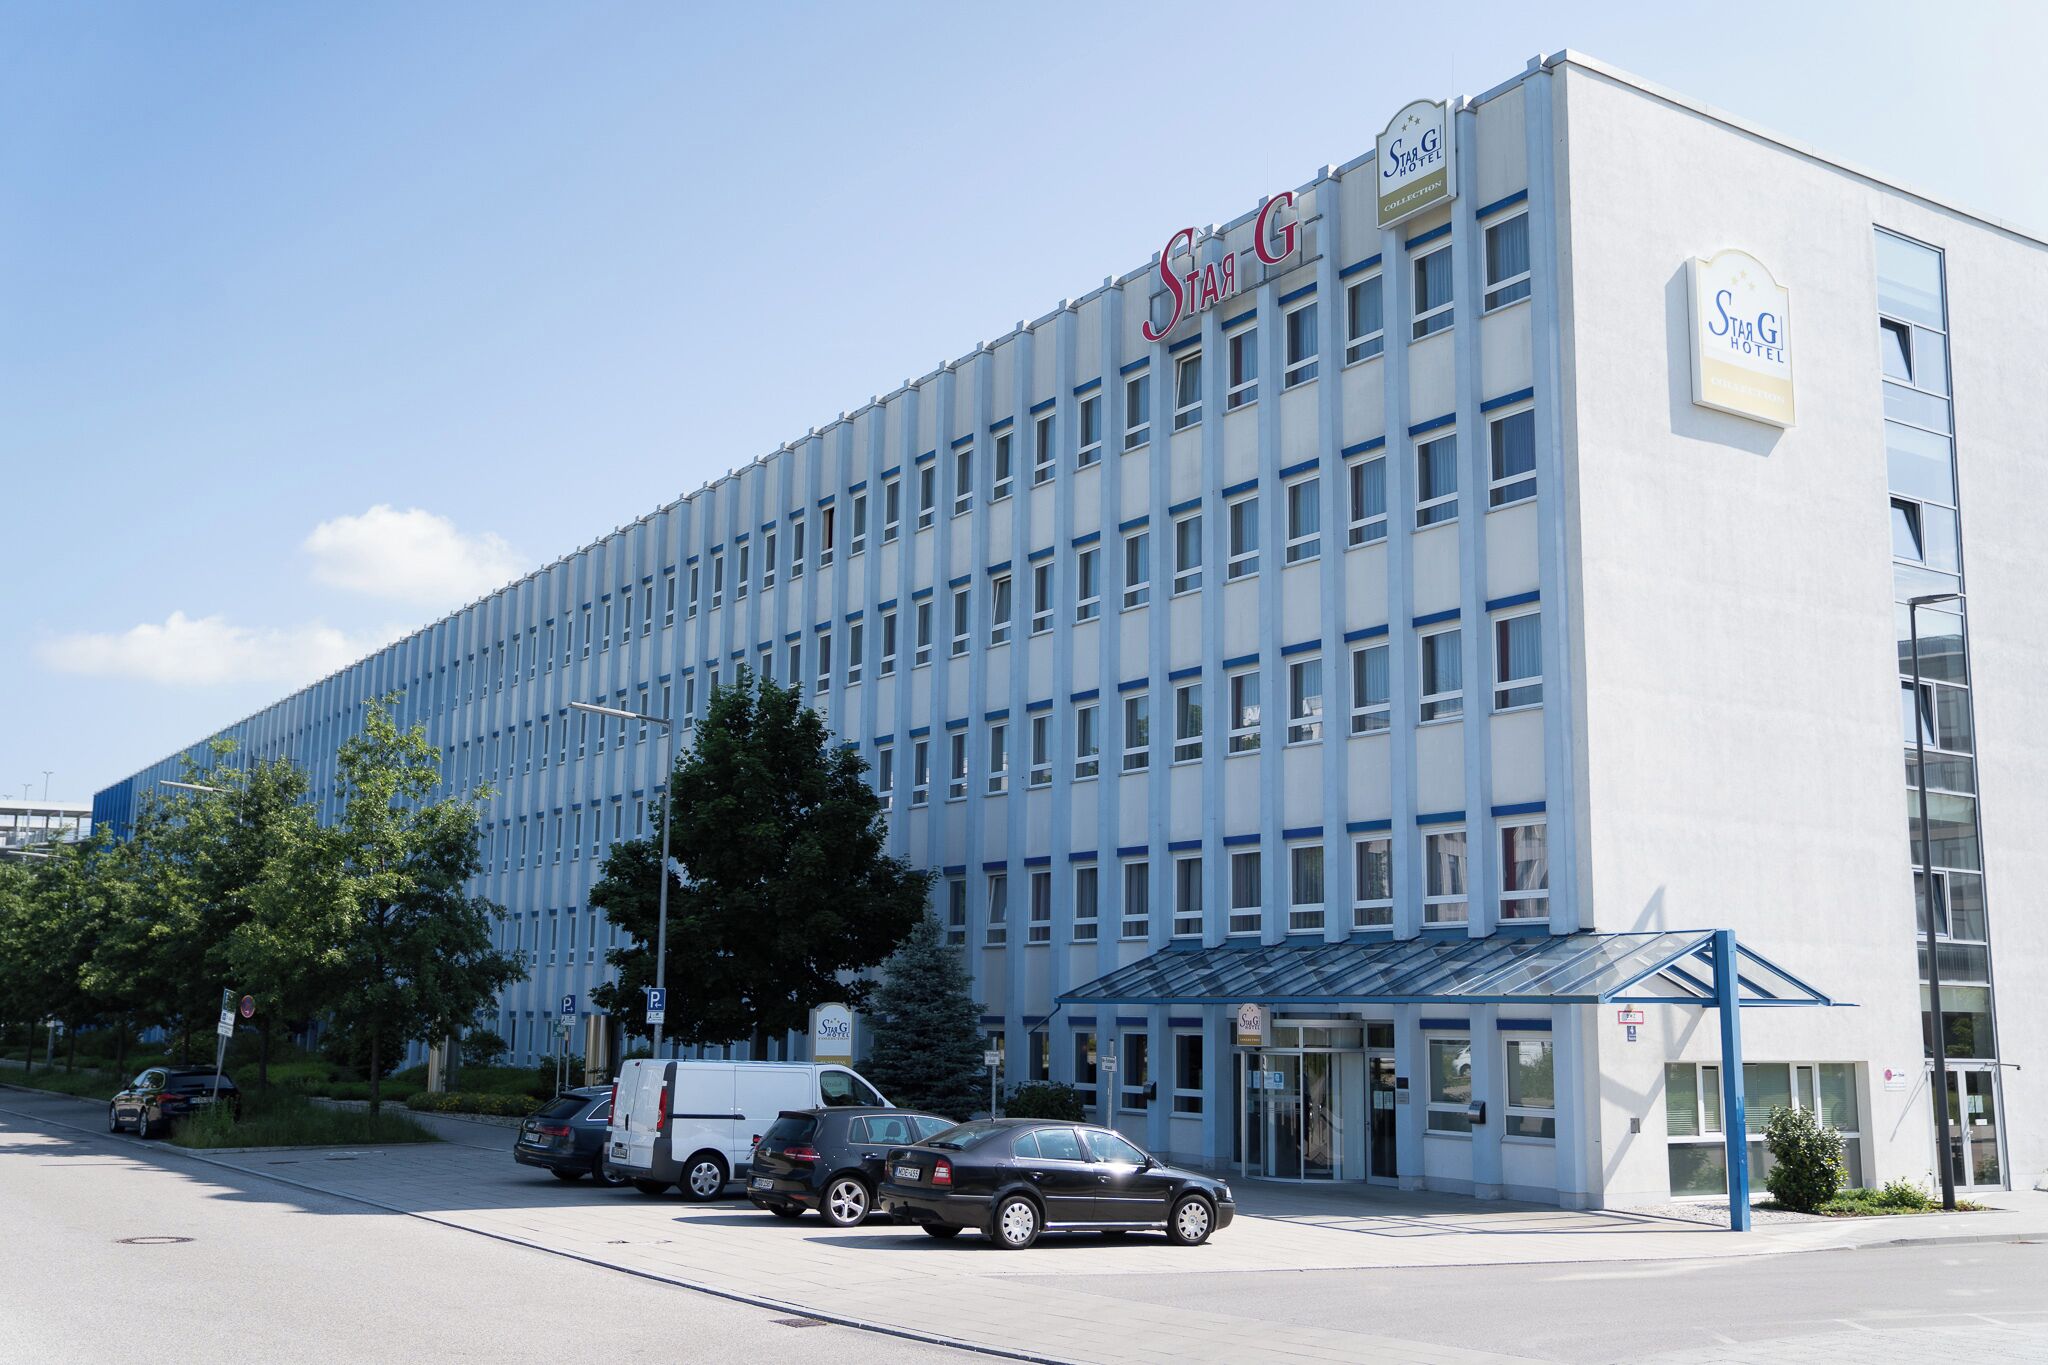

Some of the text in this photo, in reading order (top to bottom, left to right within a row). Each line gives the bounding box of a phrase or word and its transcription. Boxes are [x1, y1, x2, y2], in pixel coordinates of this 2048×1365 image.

[1421, 128, 1438, 153] G
[1400, 150, 1443, 177] HOTEL
[1384, 180, 1443, 212] COLLECTION
[1253, 191, 1299, 265] G
[1757, 312, 1778, 344] G
[1731, 336, 1784, 364] HOTEL
[650, 991, 660, 1008] P
